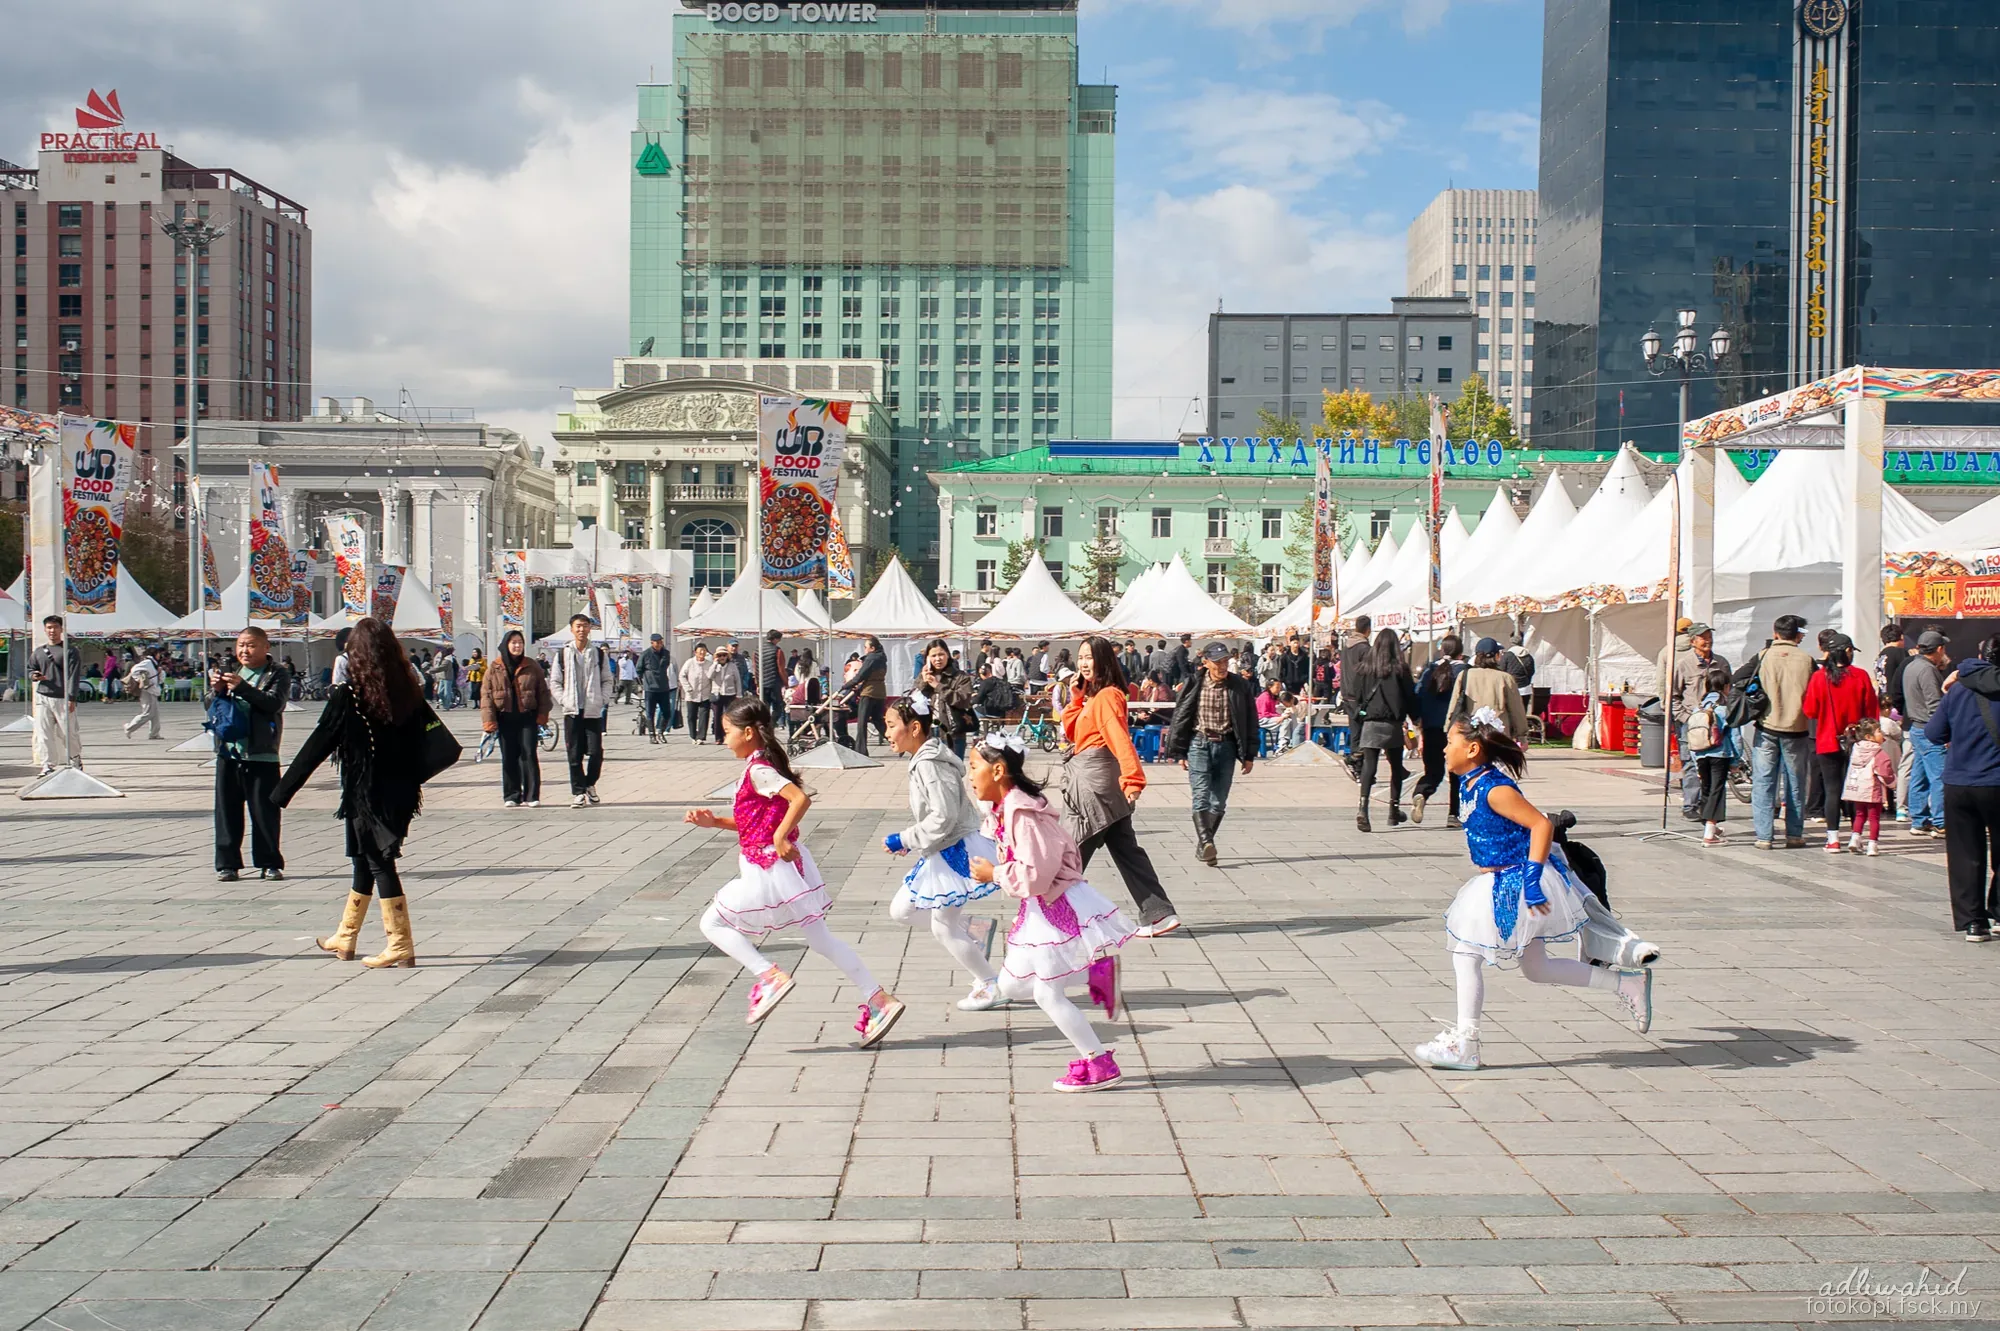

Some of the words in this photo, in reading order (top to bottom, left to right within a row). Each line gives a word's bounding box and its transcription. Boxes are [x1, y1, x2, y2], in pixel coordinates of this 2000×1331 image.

[706, 3, 780, 23] BOGD
[788, 3, 878, 23] TOWER
[41, 132, 161, 150] PRACTICAL
[776, 425, 825, 456] UB
[75, 448, 116, 480] UB
[774, 455, 822, 469] FOOD
[772, 468, 819, 478] FESTIVAL
[73, 477, 113, 493] FOOD
[72, 490, 111, 502] FESTIVAL
